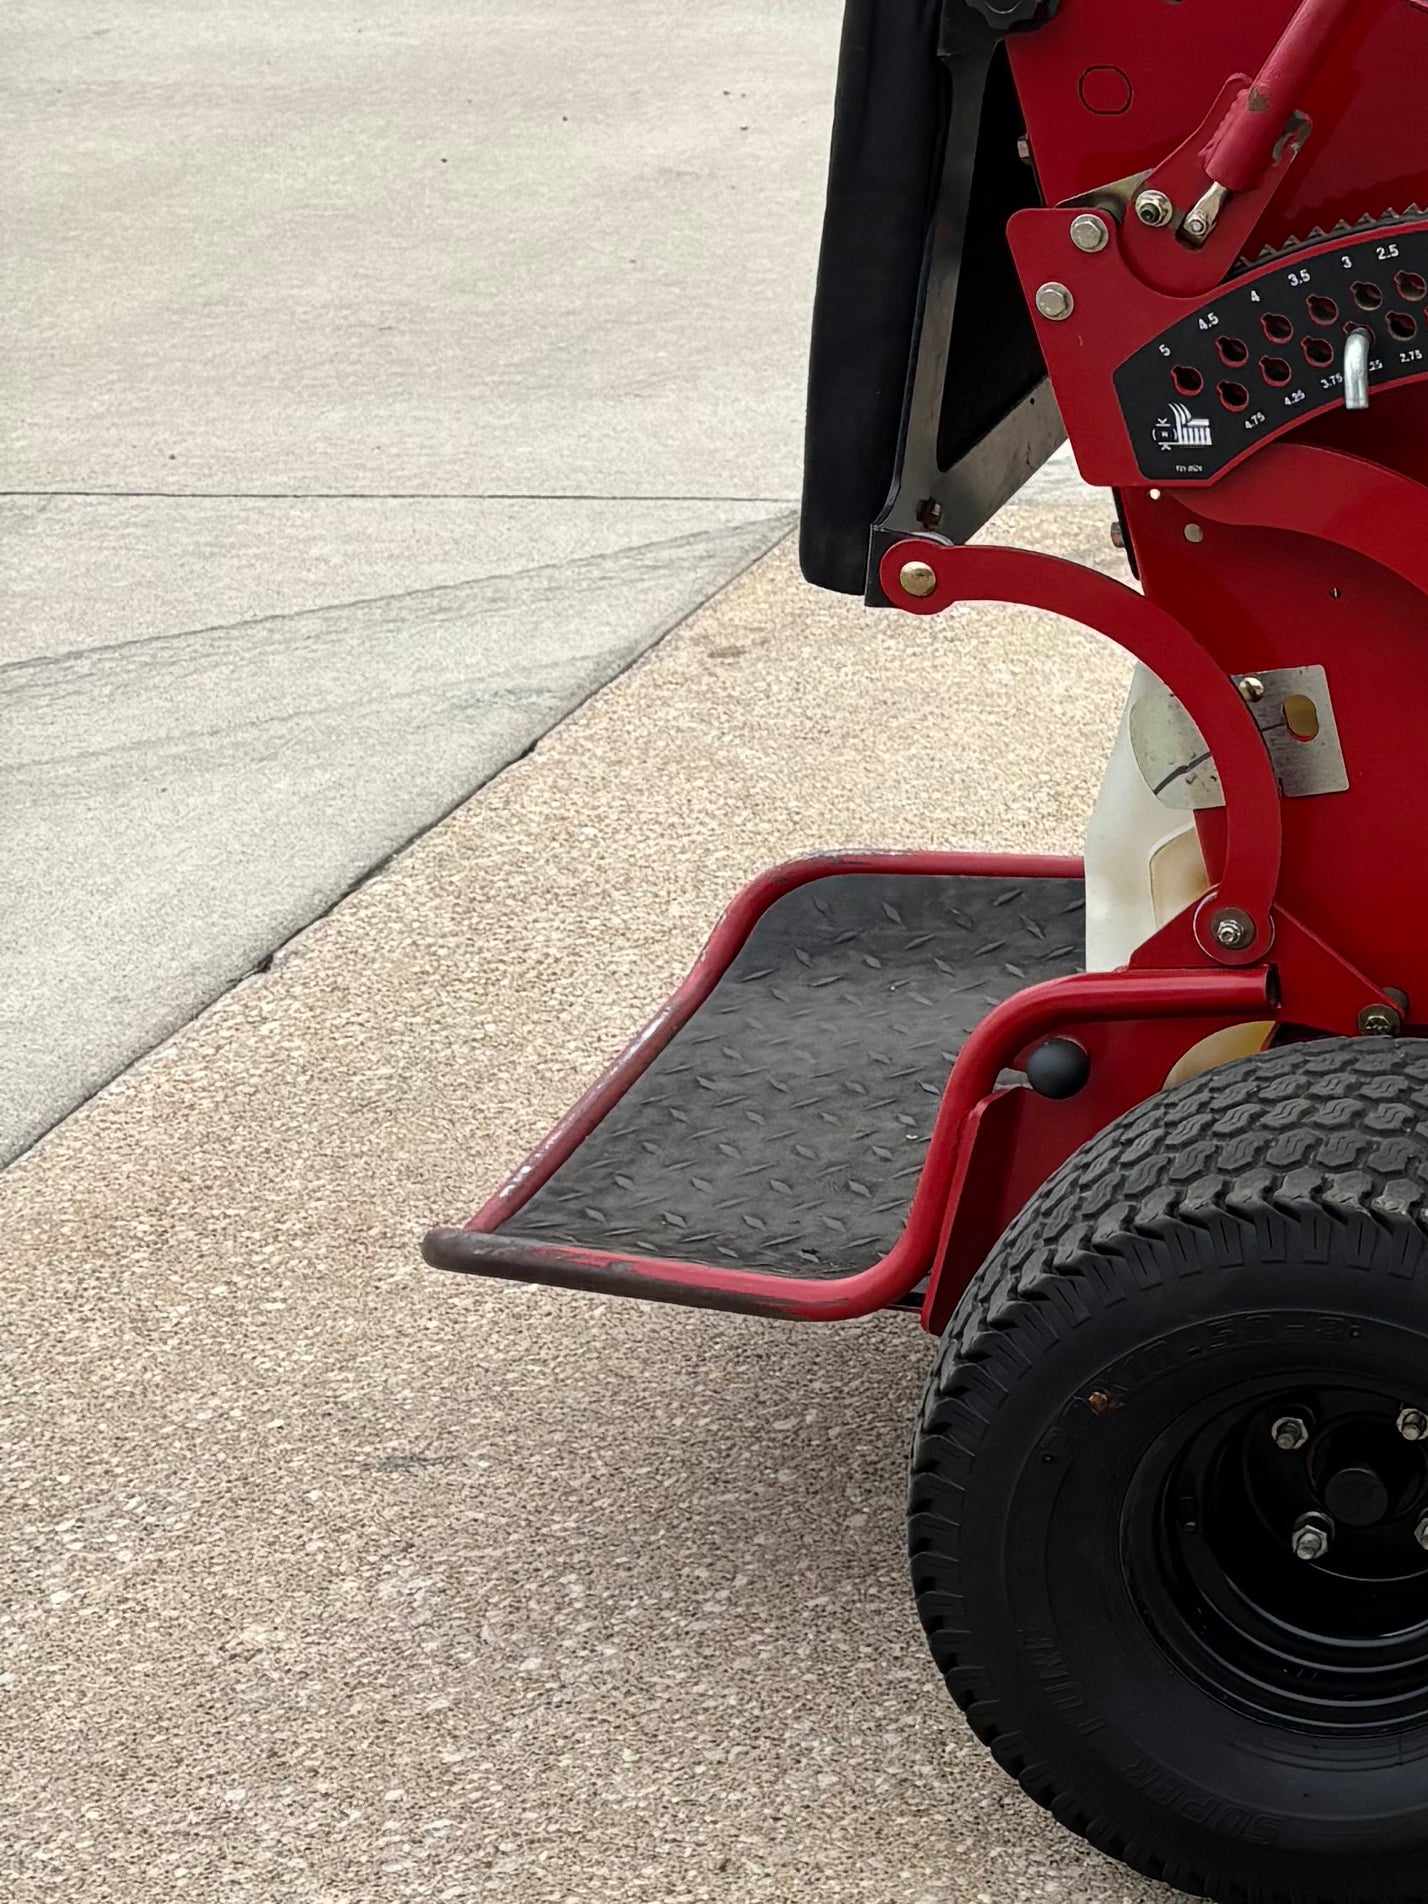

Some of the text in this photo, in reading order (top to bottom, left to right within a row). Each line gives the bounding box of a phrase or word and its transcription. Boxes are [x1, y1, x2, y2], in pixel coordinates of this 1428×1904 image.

[1158, 344, 1171, 357] 5
[1198, 312, 1219, 331] 4.5
[1250, 290, 1261, 302] 4
[1287, 269, 1311, 287] 3.5
[1341, 256, 1352, 269] 3
[1376, 244, 1399, 260] 2.5
[1244, 412, 1266, 429] 4.75
[1284, 390, 1306, 406] 4.25
[1320, 372, 1343, 389] 3.75
[1368, 359, 1384, 371] 25
[1400, 349, 1423, 363] 2.75
